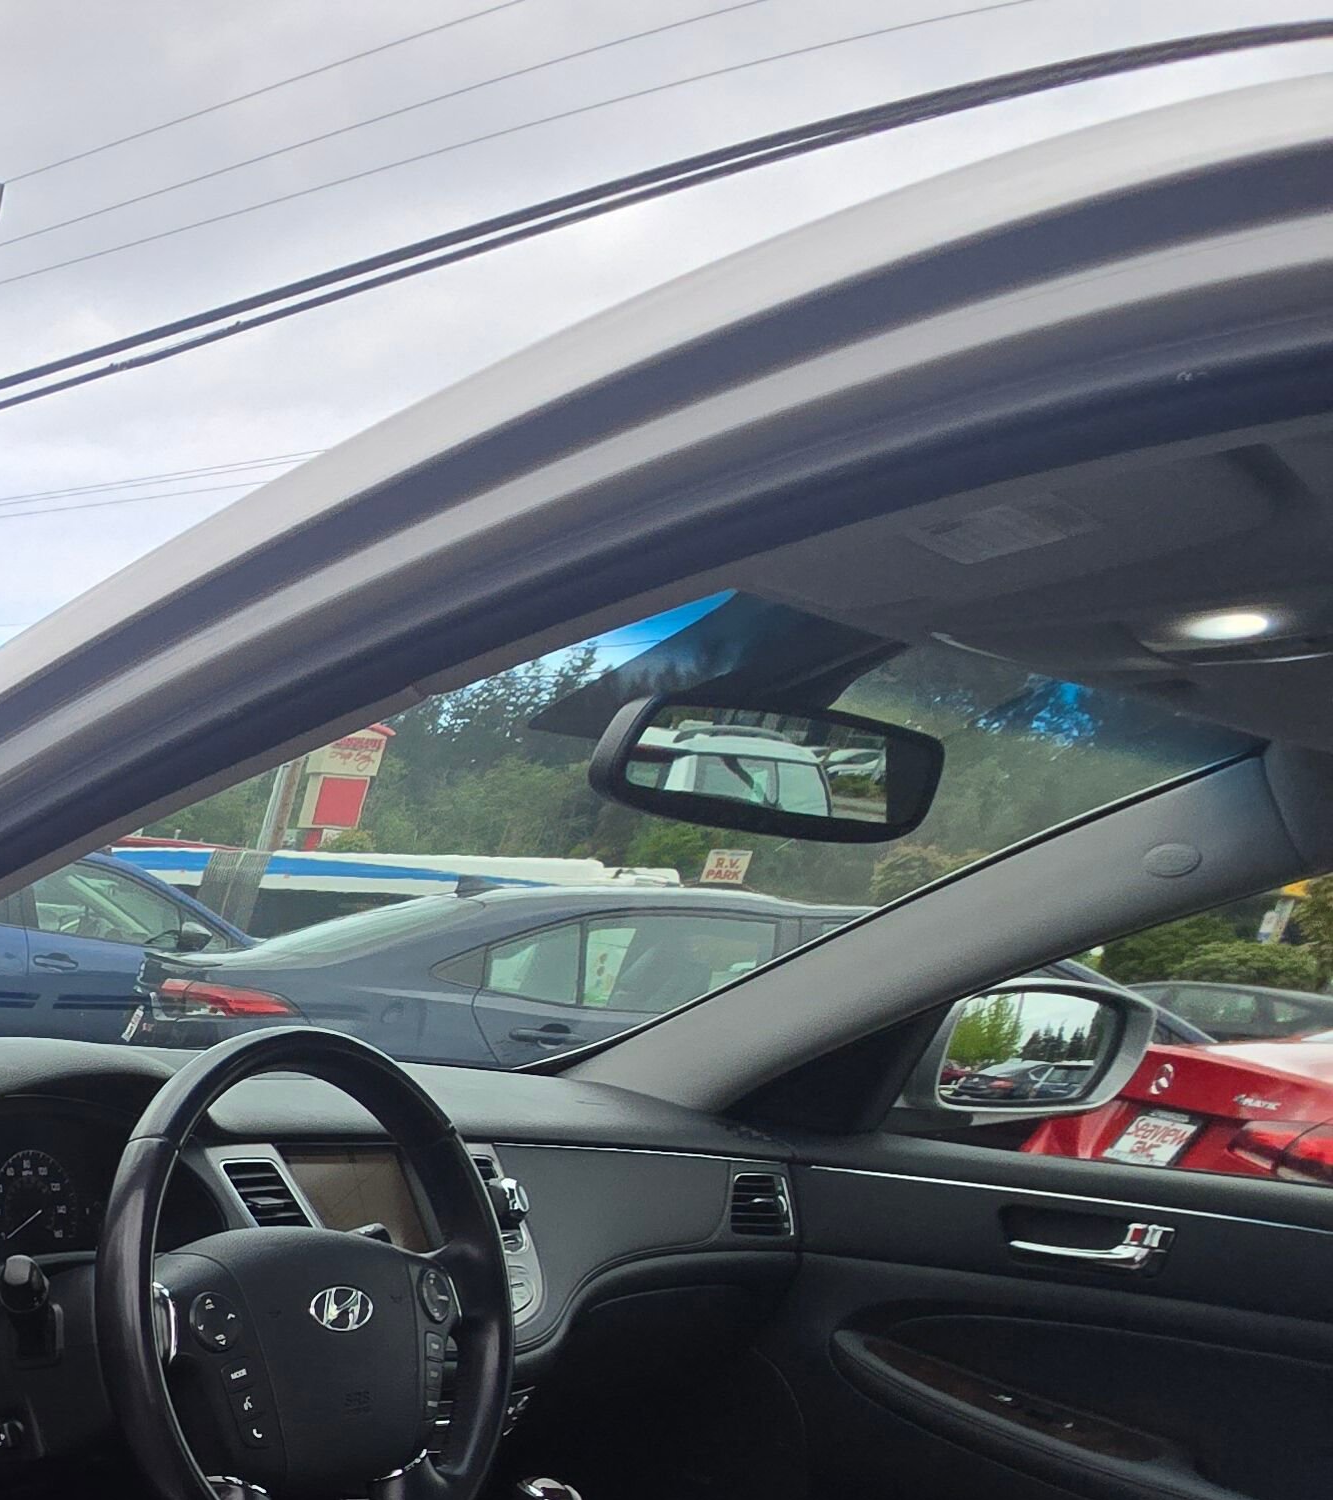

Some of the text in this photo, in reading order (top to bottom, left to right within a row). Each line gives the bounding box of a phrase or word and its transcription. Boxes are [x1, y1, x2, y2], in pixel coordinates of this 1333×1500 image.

[715, 857, 740, 869] R.V.
[705, 869, 742, 880] PARK
[1125, 1117, 1190, 1146] Seaview
